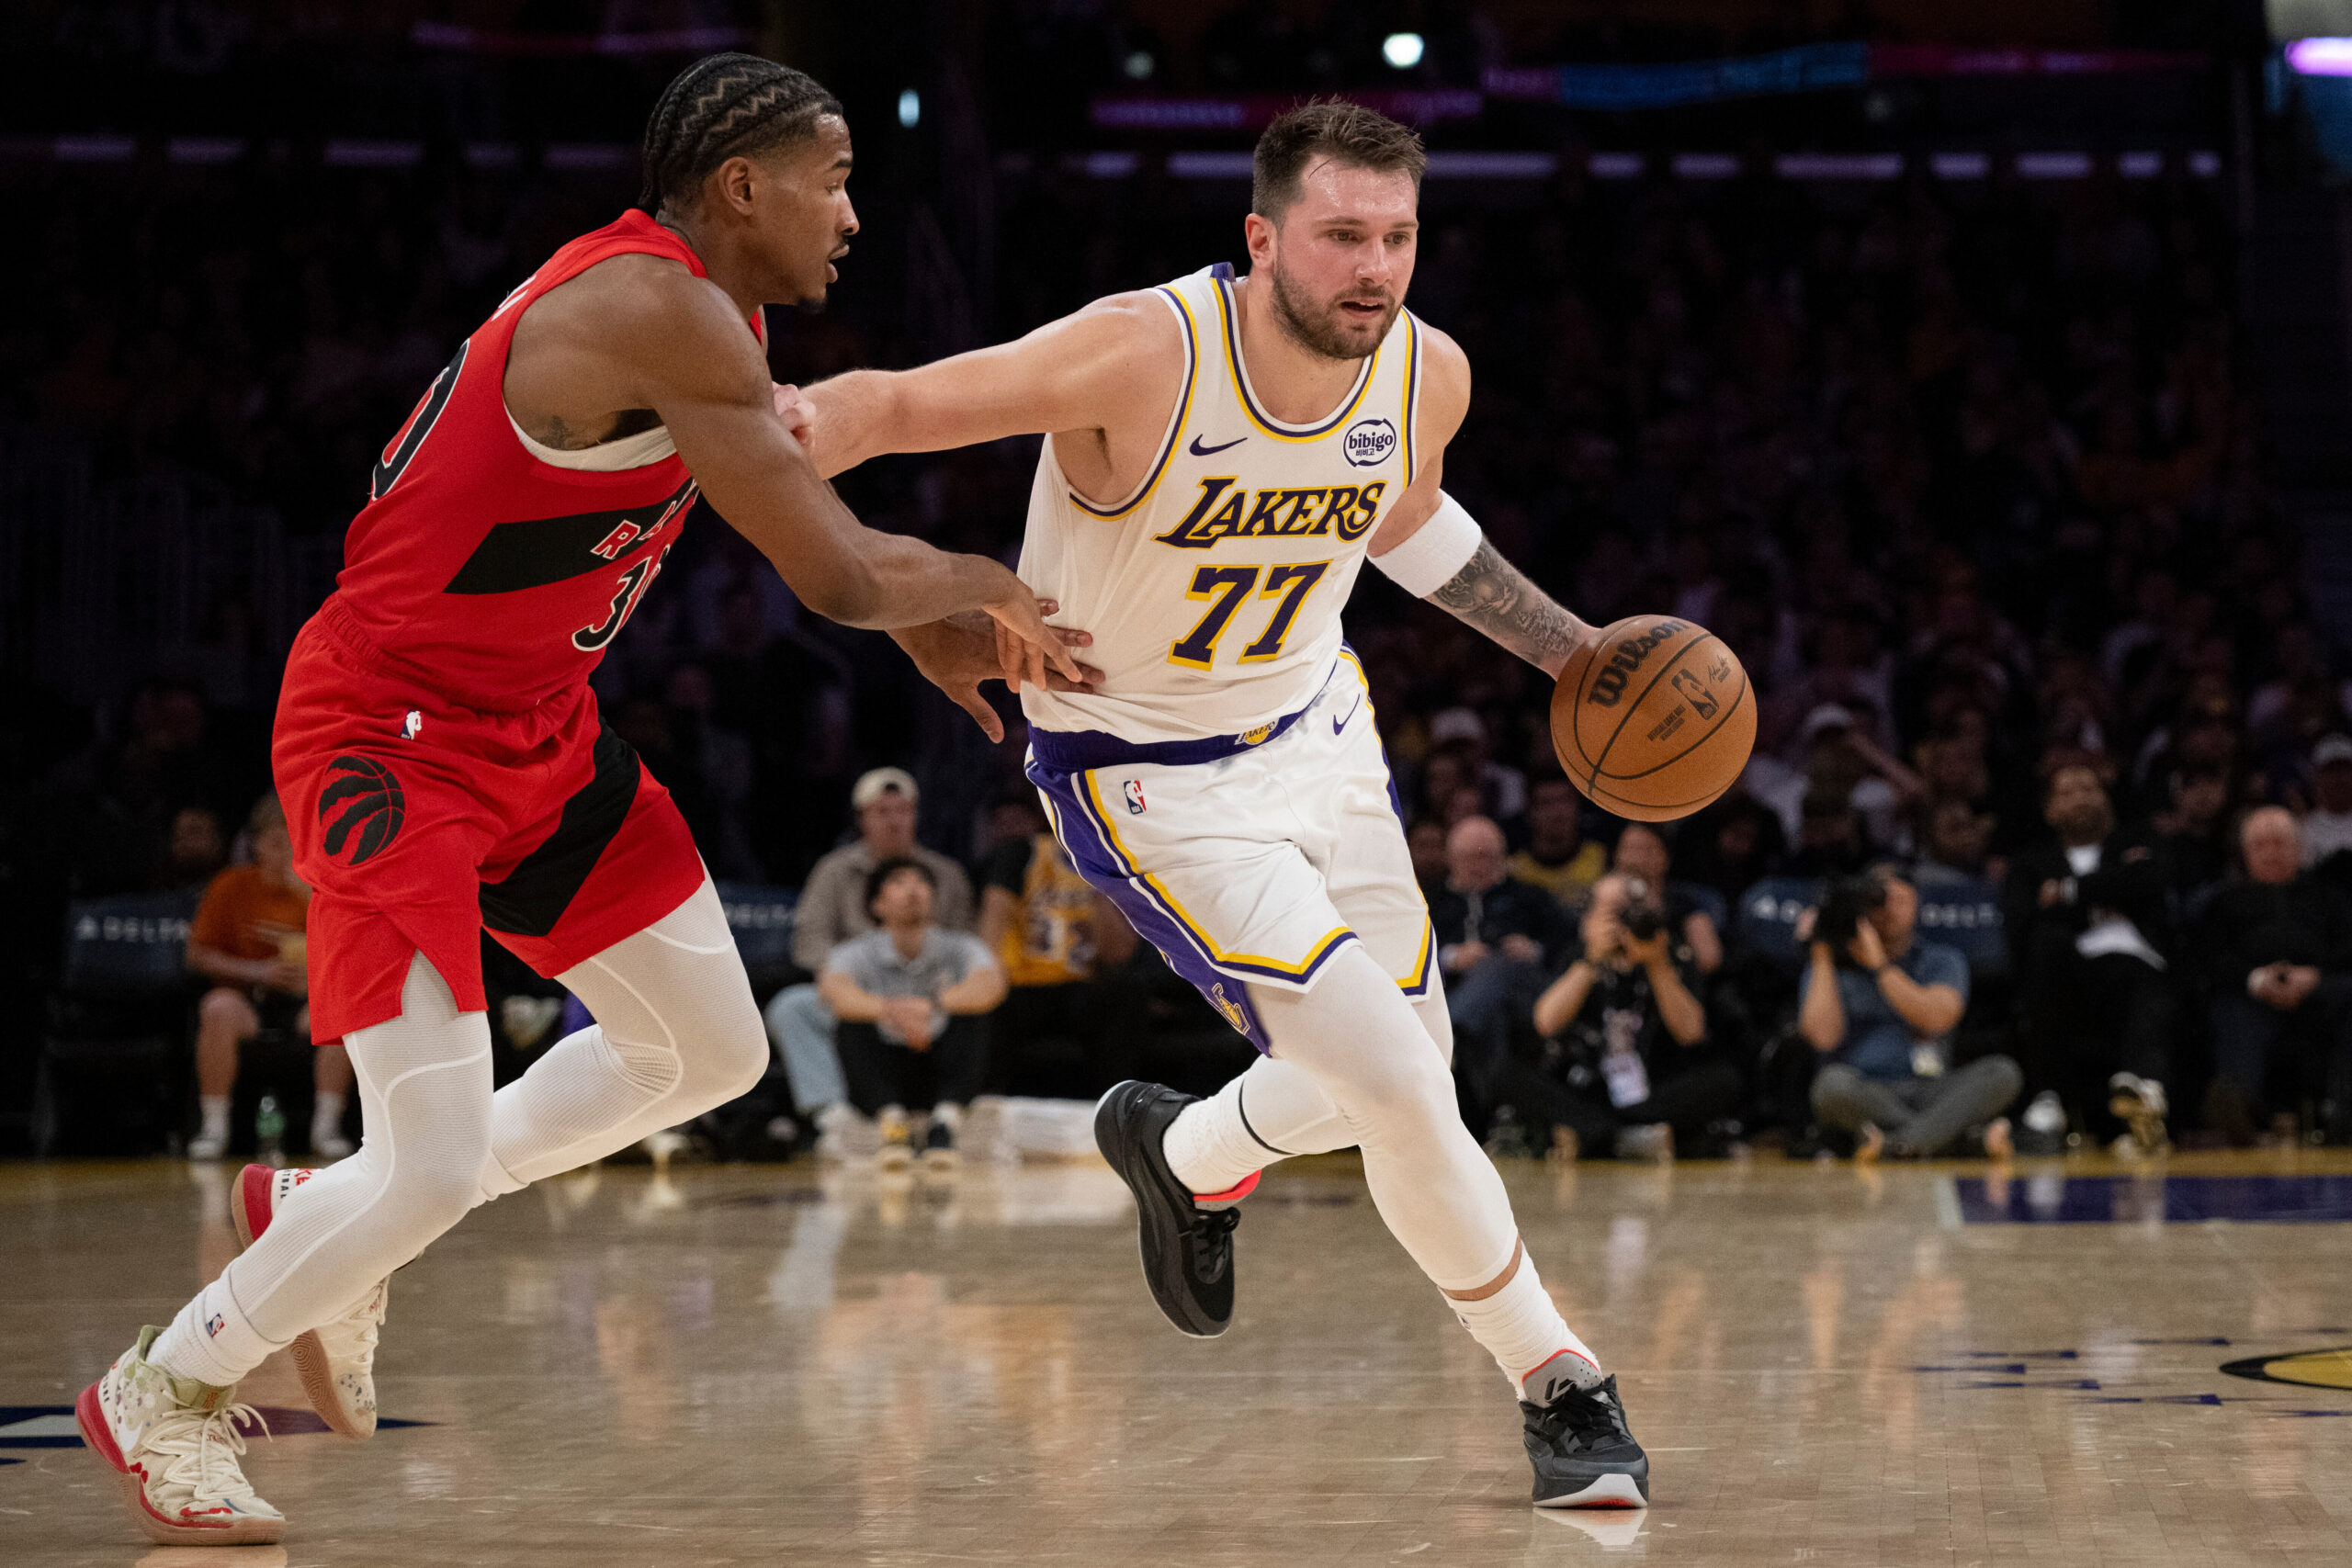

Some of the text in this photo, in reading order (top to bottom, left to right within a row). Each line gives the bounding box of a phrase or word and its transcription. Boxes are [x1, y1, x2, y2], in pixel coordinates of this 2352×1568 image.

[1349, 432, 1394, 452] bibigo
[1355, 448, 1375, 457] 비비고
[1150, 475, 1388, 550] LAKERS
[1167, 558, 1334, 671] 77
[1587, 620, 1690, 708] Wilson
